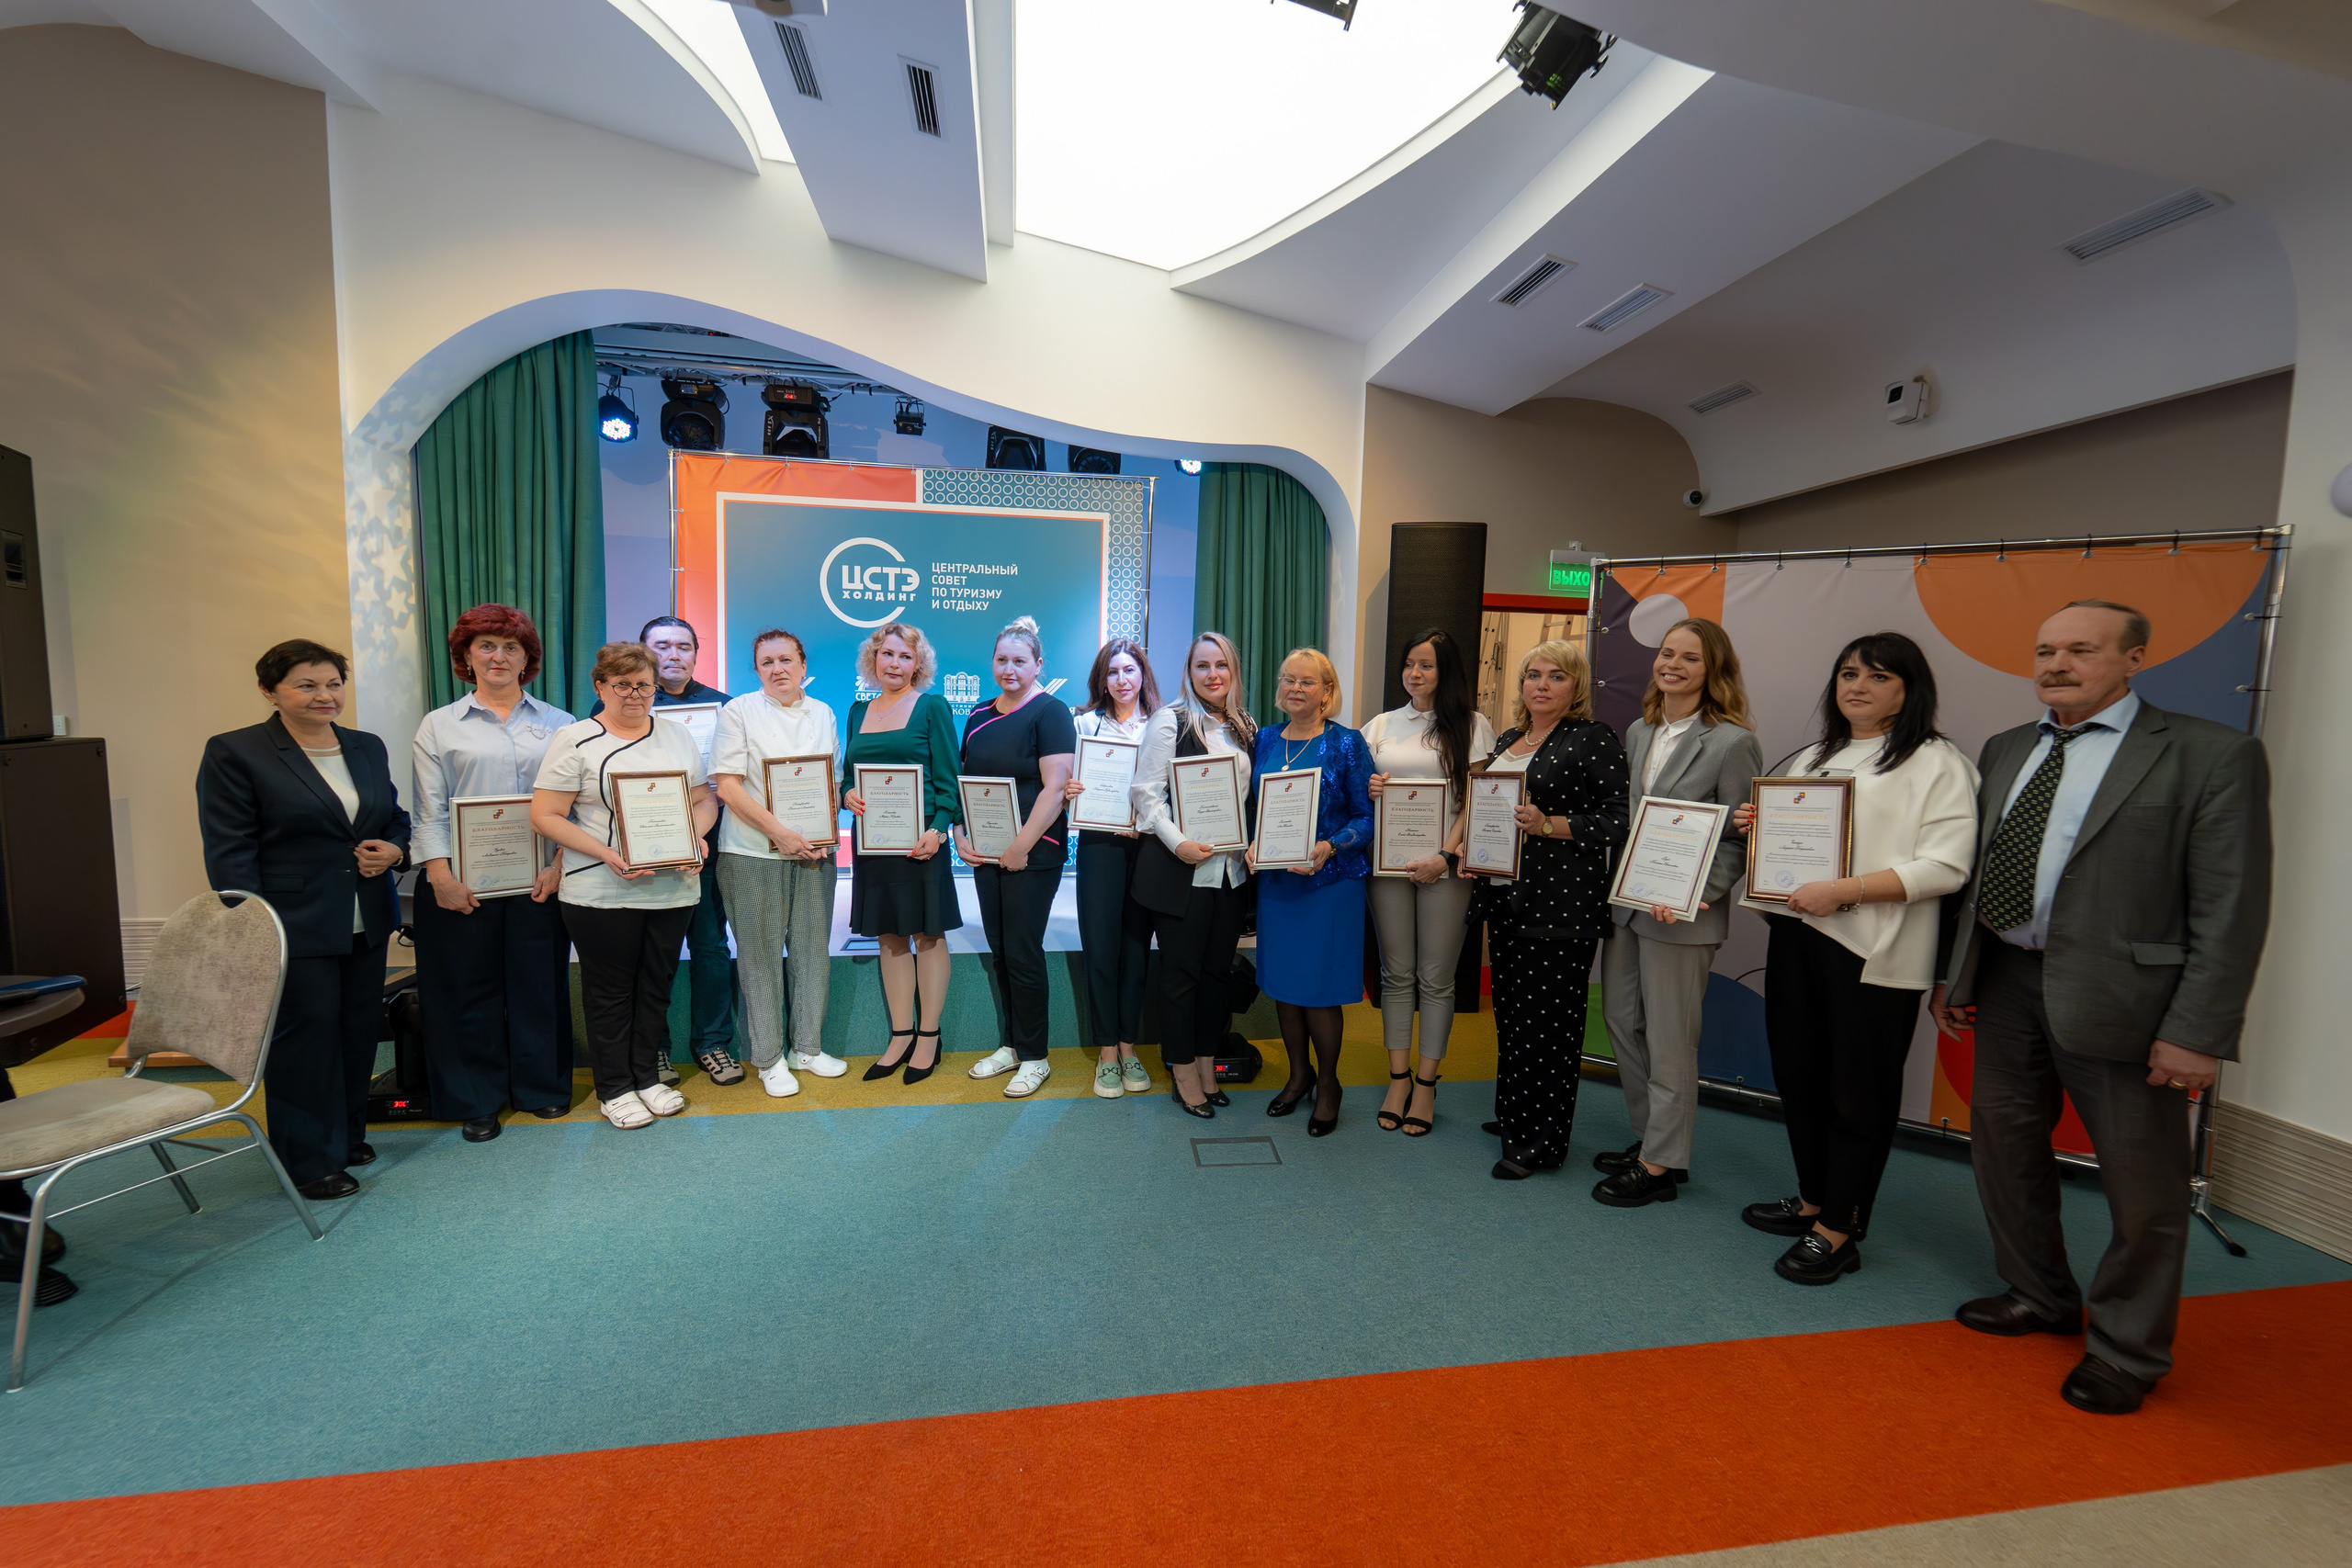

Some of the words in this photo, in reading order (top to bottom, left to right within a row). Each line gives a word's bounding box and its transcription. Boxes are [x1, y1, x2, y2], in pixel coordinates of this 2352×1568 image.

[932, 562, 1018, 575] ЦЕНТРАЛЬНЫЙ
[842, 564, 921, 592] ЦСТЭ
[932, 575, 967, 586] СОВЕТ
[1553, 570, 1591, 586] ВЫХО
[842, 590, 917, 602] ХОЛДИНГ
[932, 587, 947, 597] ПО
[950, 588, 1002, 599] ТУРИЗМУ
[932, 599, 940, 609] И
[943, 600, 989, 612] ОТДЫХУ
[471, 825, 526, 833] БЛАГОДАРНОСТЬ
